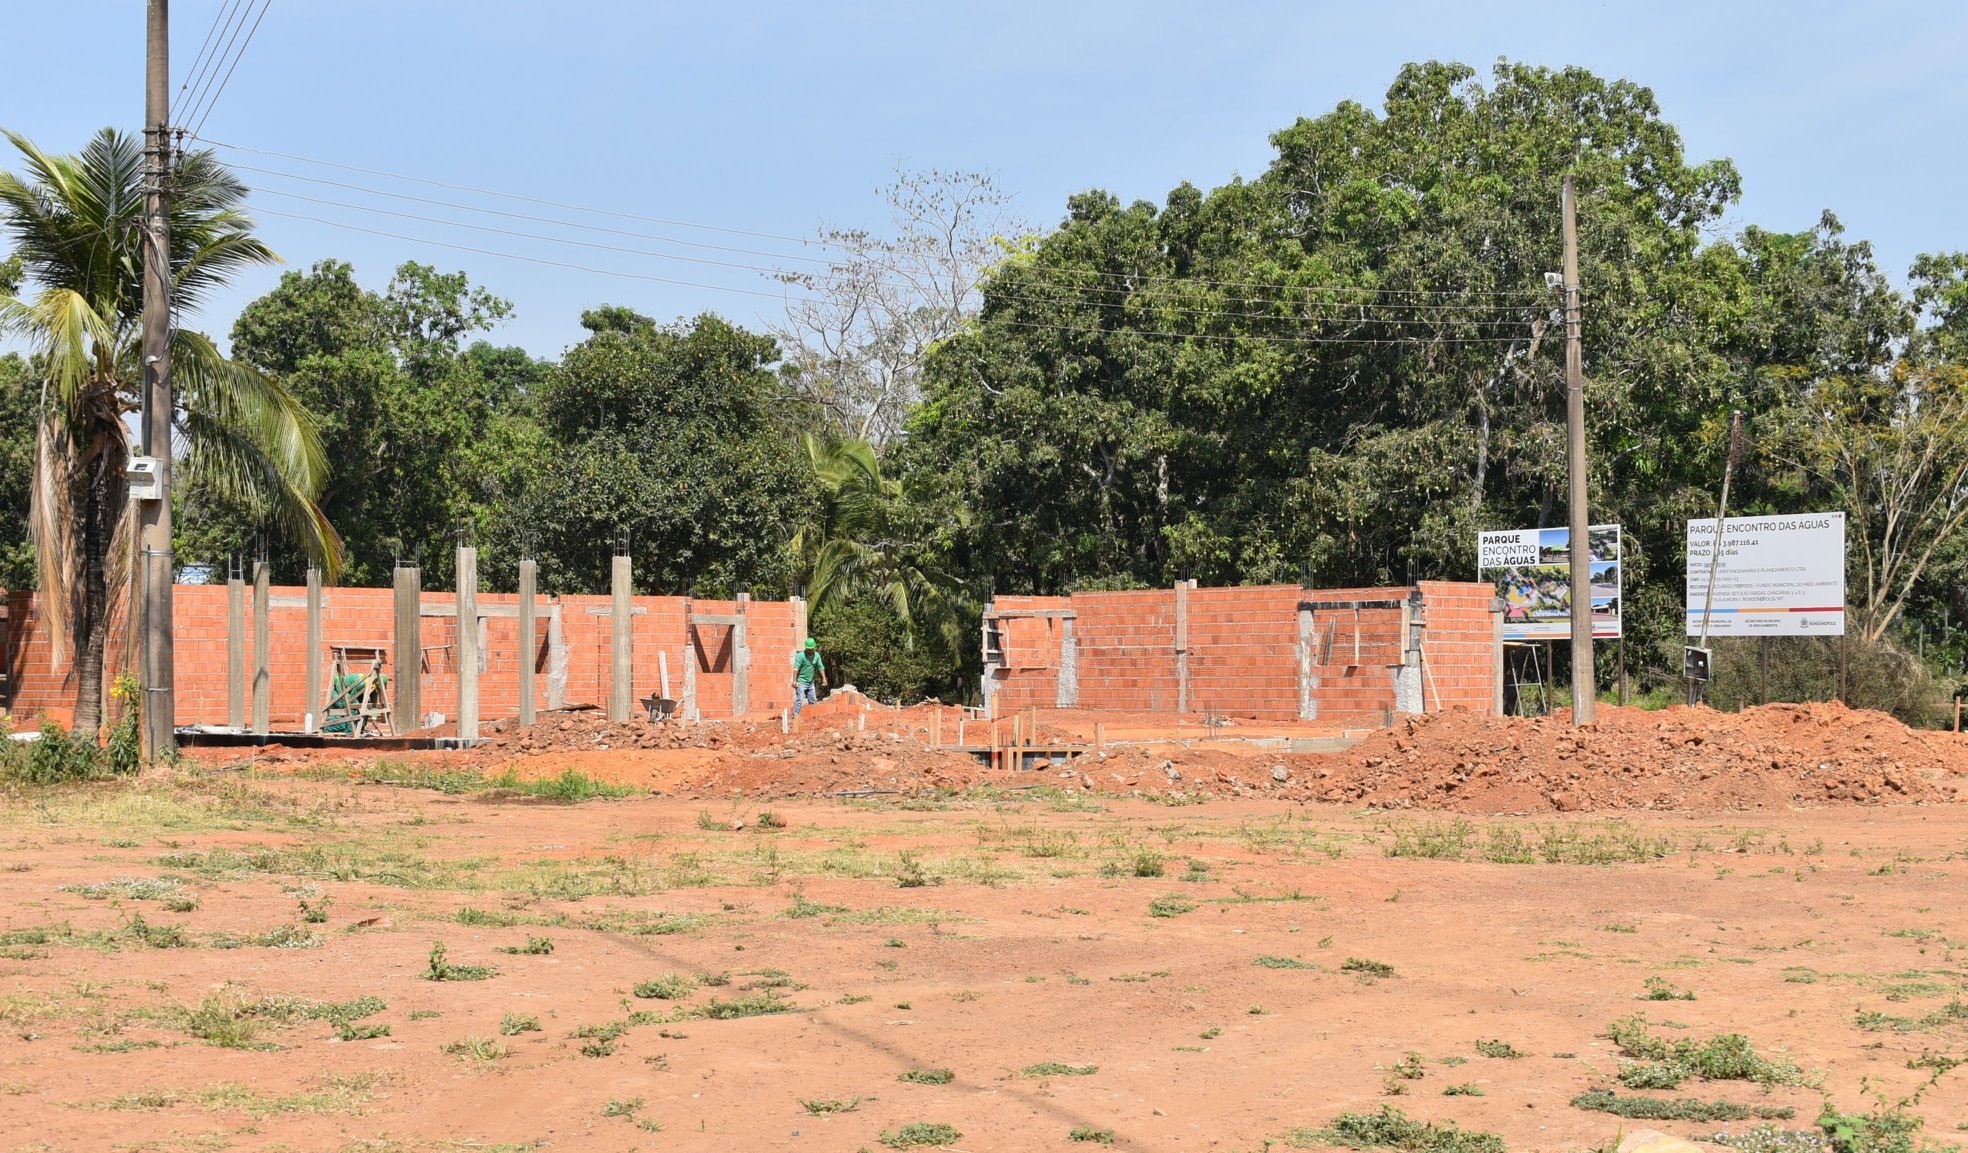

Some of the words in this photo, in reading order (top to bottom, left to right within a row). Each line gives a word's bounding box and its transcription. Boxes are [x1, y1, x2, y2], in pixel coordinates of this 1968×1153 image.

[1690, 525, 1724, 534] PARQUE
[1727, 523, 1776, 533] ENCONTRO
[1778, 521, 1797, 531] DAS
[1798, 518, 1830, 530] ÁGUAS
[1483, 535, 1520, 544] PARQUE
[1483, 545, 1536, 555] ENCONTRO
[1483, 557, 1502, 566] DAS
[1503, 555, 1535, 565] ÁGUAS
